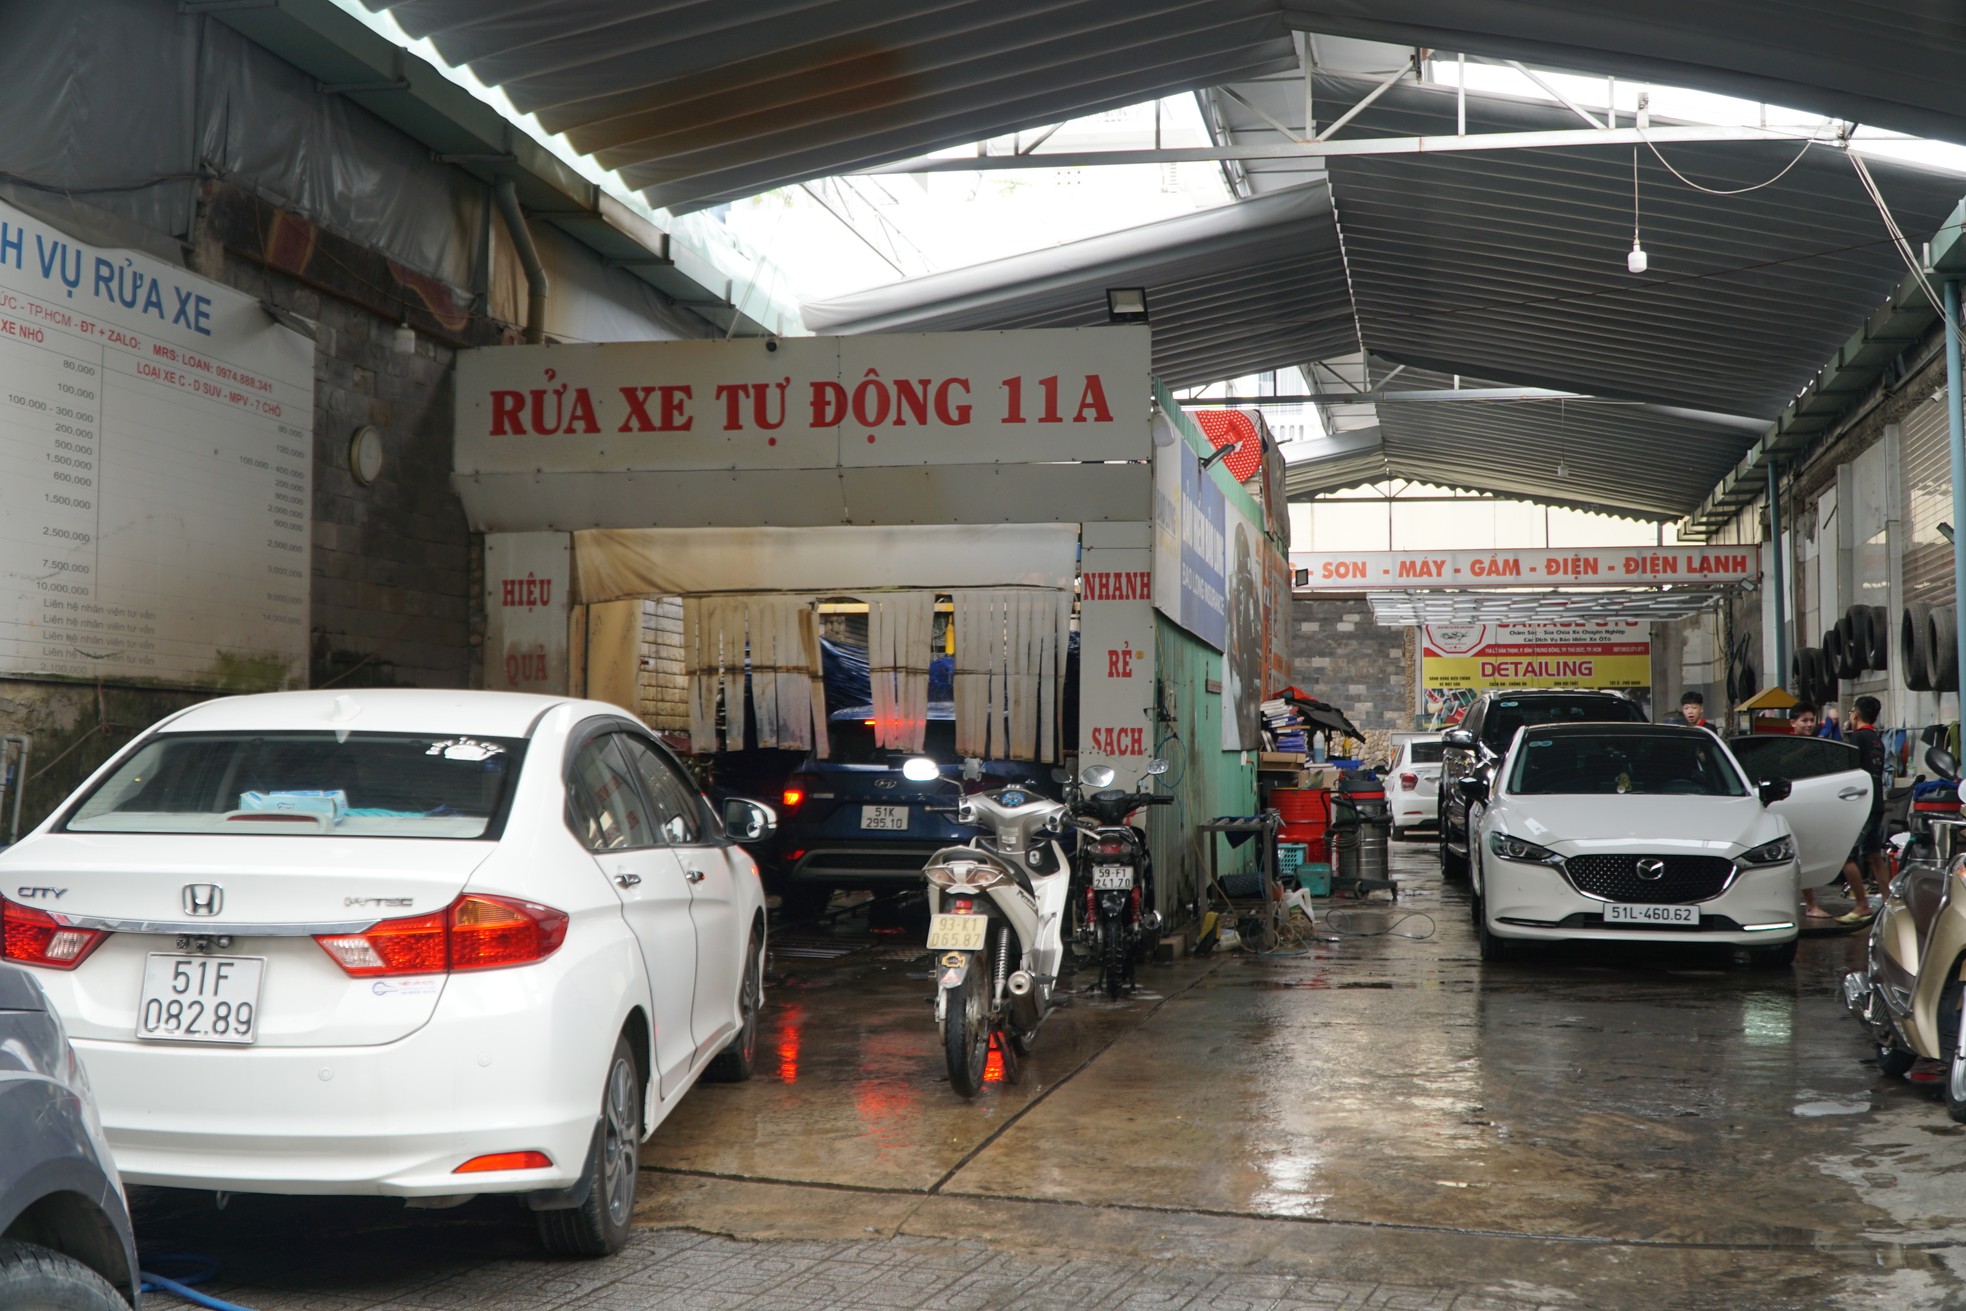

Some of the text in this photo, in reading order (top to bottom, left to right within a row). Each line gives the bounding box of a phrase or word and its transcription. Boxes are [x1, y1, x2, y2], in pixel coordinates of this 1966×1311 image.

[0, 222, 212, 336] H VỤ RỬA XE
[1, 319, 44, 343] XE NHỎ
[27, 302, 71, 327] TP.HCM
[80, 320, 96, 335] ĐT
[108, 329, 141, 350] ZALO:
[153, 344, 179, 362] MRS:
[183, 353, 213, 374] LOAN:
[137, 362, 161, 381] LOẠI
[163, 369, 176, 383] XE
[179, 375, 186, 387] C
[193, 379, 201, 391] D
[203, 382, 222, 398] SUV
[229, 391, 249, 407] MPV
[256, 399, 261, 410] 7
[489, 367, 1114, 448] RỬA XE TỰ ĐỘNG 11A
[1322, 561, 1367, 580] SƠN
[1398, 556, 1447, 578] MÁY
[1470, 553, 1521, 577] GẦM
[1545, 554, 1599, 580] ĐIỆN
[1623, 553, 1678, 579] ĐIỆN
[1686, 555, 1747, 578] LẠNH
[501, 571, 552, 614] HIỆU
[1083, 571, 1151, 601] NHANH
[505, 644, 548, 688] QUẢ
[1107, 640, 1133, 678] RẺ
[1481, 661, 1593, 677] DETAILING
[866, 818, 902, 829] 295.10
[875, 807, 895, 817] 51K
[1095, 878, 1131, 888] 241.70
[1099, 868, 1126, 878] 59-F1
[18, 887, 68, 899] CITY
[940, 917, 978, 932] 93-K1
[1612, 907, 1691, 921] 51L-460.62
[930, 932, 981, 947] 065.87
[172, 960, 235, 997] 51F
[144, 998, 253, 1036] 082.89
